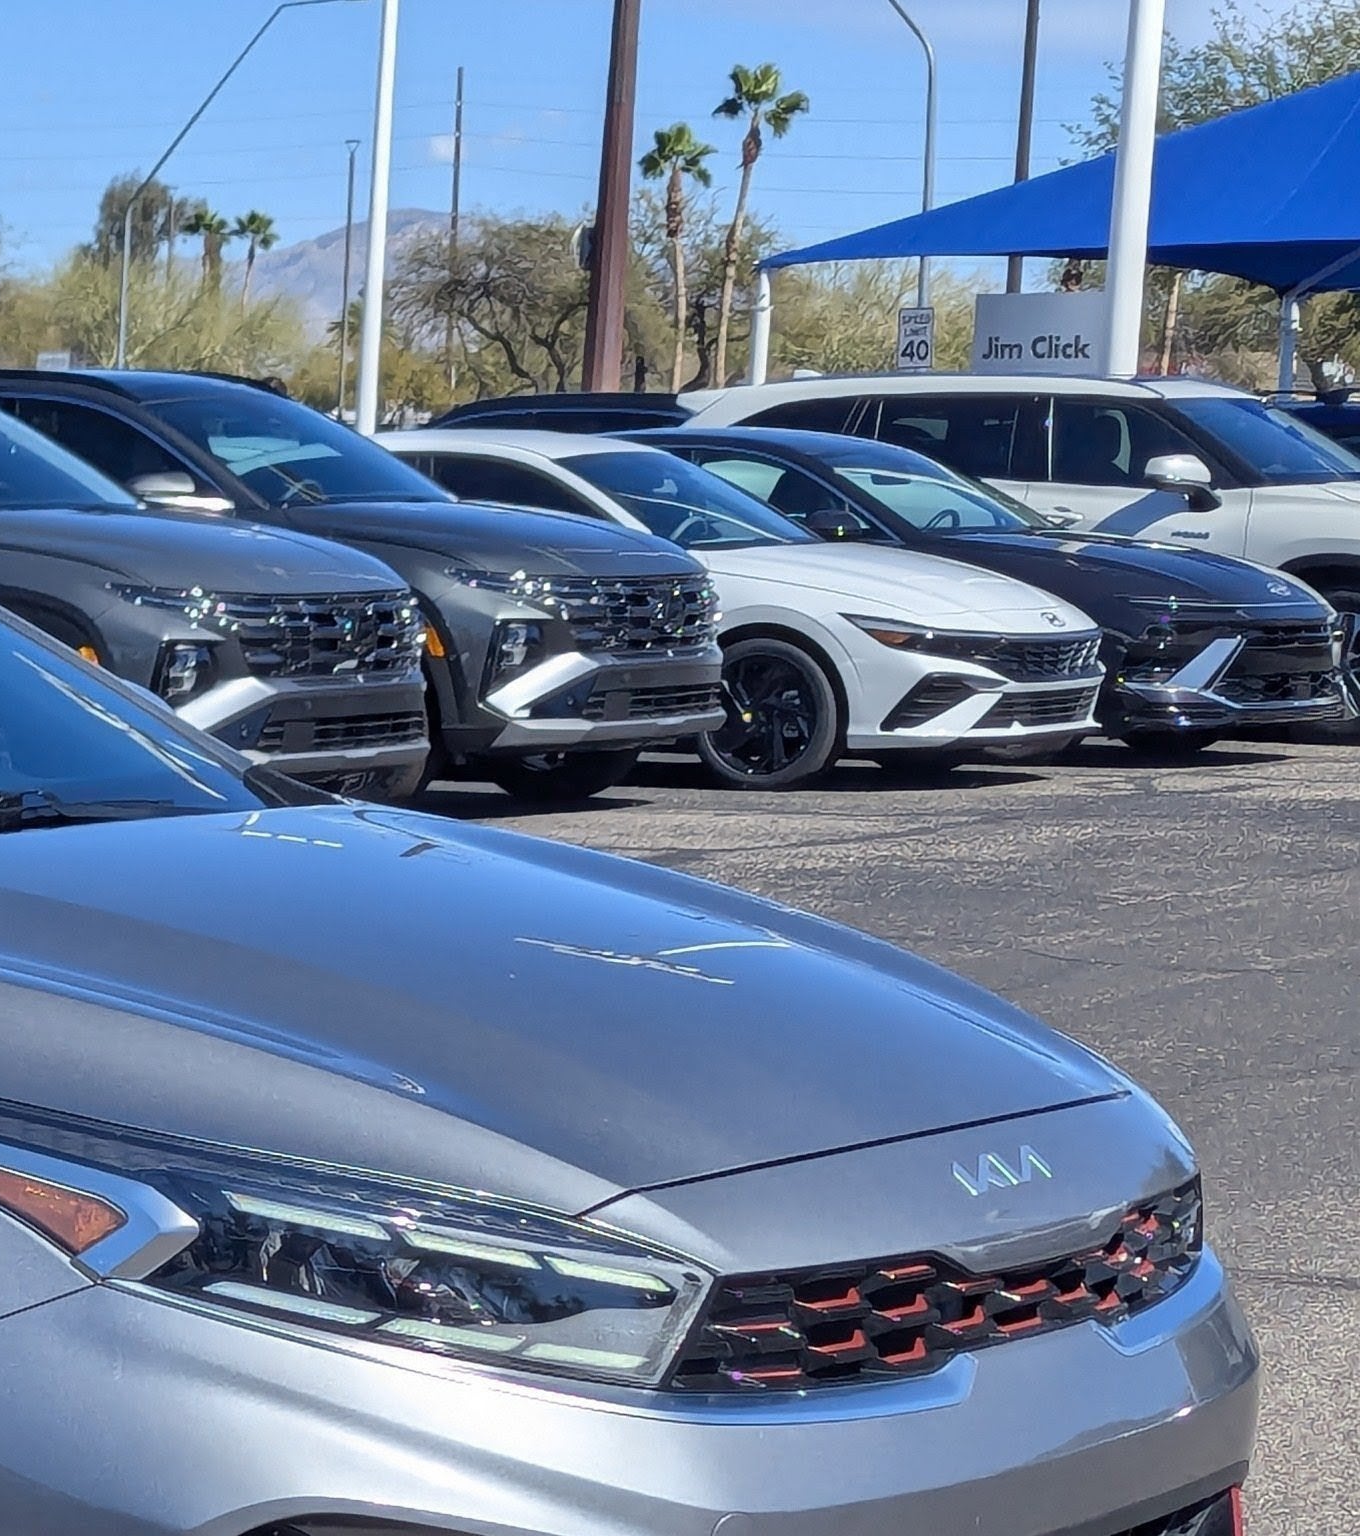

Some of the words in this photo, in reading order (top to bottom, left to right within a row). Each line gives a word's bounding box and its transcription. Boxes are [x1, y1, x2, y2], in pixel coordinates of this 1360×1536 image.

[901, 340, 929, 361] 40
[982, 336, 1023, 360] Jim
[1031, 335, 1091, 360] Click
